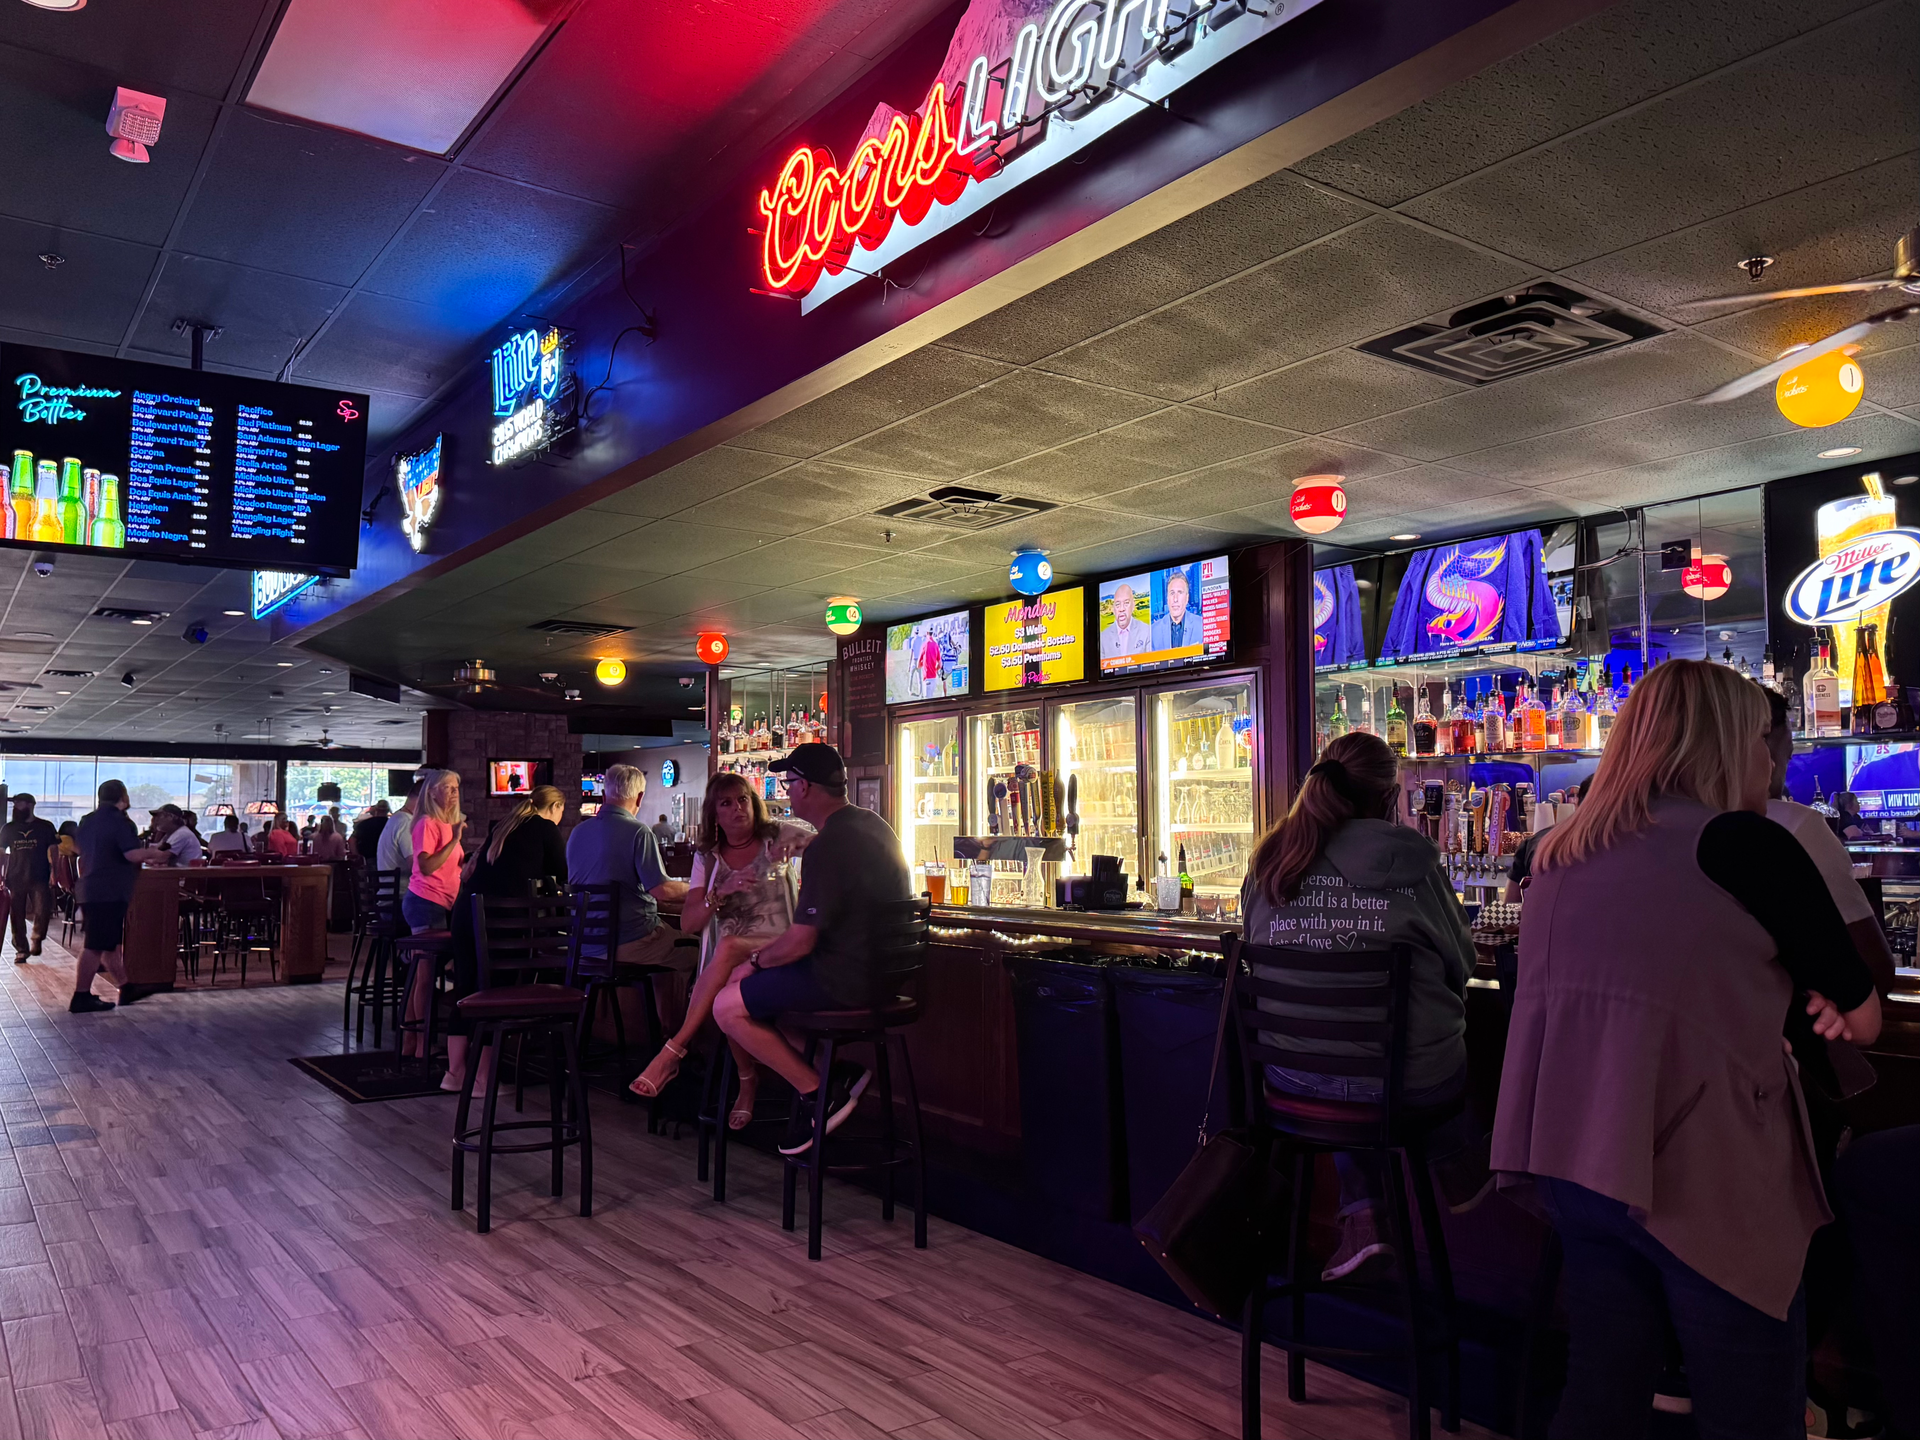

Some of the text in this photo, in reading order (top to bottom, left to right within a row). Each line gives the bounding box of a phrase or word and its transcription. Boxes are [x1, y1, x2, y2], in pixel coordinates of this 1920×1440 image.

[760, 0, 1212, 289] Coors LIGH
[492, 328, 540, 417] Lite
[15, 373, 121, 399] Premium
[134, 390, 200, 406] Angry Orchard
[19, 396, 87, 424] Bottles
[133, 404, 214, 422] Boulevard Pale Ale
[238, 405, 273, 416] Pacifico
[132, 418, 177, 431] Boulevard
[179, 424, 209, 435] Wheat
[238, 418, 254, 427] Bud
[256, 421, 292, 432] Platinum
[132, 432, 177, 445] Boulevard
[178, 438, 199, 448] Tank
[237, 432, 256, 440] Sam
[257, 434, 286, 444] Adams
[287, 438, 315, 449] Boston
[317, 441, 340, 451] Lager
[131, 446, 165, 457] Corona
[236, 445, 274, 456] Smirnoff
[275, 450, 287, 458] Ice
[131, 460, 163, 471] Corona
[165, 463, 201, 474] Premier
[236, 458, 260, 468] Stella
[261, 462, 287, 471] Artois
[130, 474, 198, 488] Dos Equis Lager
[235, 471, 272, 483] Michelob
[273, 476, 295, 485] Ultra
[129, 488, 202, 501] Dos Equis Amber
[234, 485, 271, 495] Michelob
[272, 489, 293, 498] Ultra
[295, 491, 326, 501] Infusion
[128, 501, 169, 512] Heineken
[234, 498, 311, 513] Voodoo Ranger IPA
[128, 515, 161, 525] Modelo
[233, 511, 297, 525] Yuengling Lager
[127, 529, 160, 538] Modelo
[161, 531, 189, 541] Negra
[232, 524, 295, 538] Yuengling Flight
[1825, 542, 1893, 571] Miller
[1202, 561, 1213, 574] PTI
[1811, 551, 1911, 622] Lite
[1004, 597, 1057, 624] Monday
[1014, 623, 1047, 639] $3 Wells
[842, 639, 882, 660] BULLEIT
[989, 634, 1075, 657] $2.50 Domestic Bottles
[850, 662, 875, 672] WHISKEY
[852, 655, 872, 663] FRONTIER
[1001, 651, 1062, 669] $3.50 Premiums
[1300, 874, 1344, 890] person
[1289, 890, 1324, 907] world
[1327, 892, 1338, 908] is
[1340, 897, 1348, 909] a
[1352, 892, 1390, 910] better
[1270, 912, 1386, 938] place with you in it.
[1307, 933, 1333, 950] love
